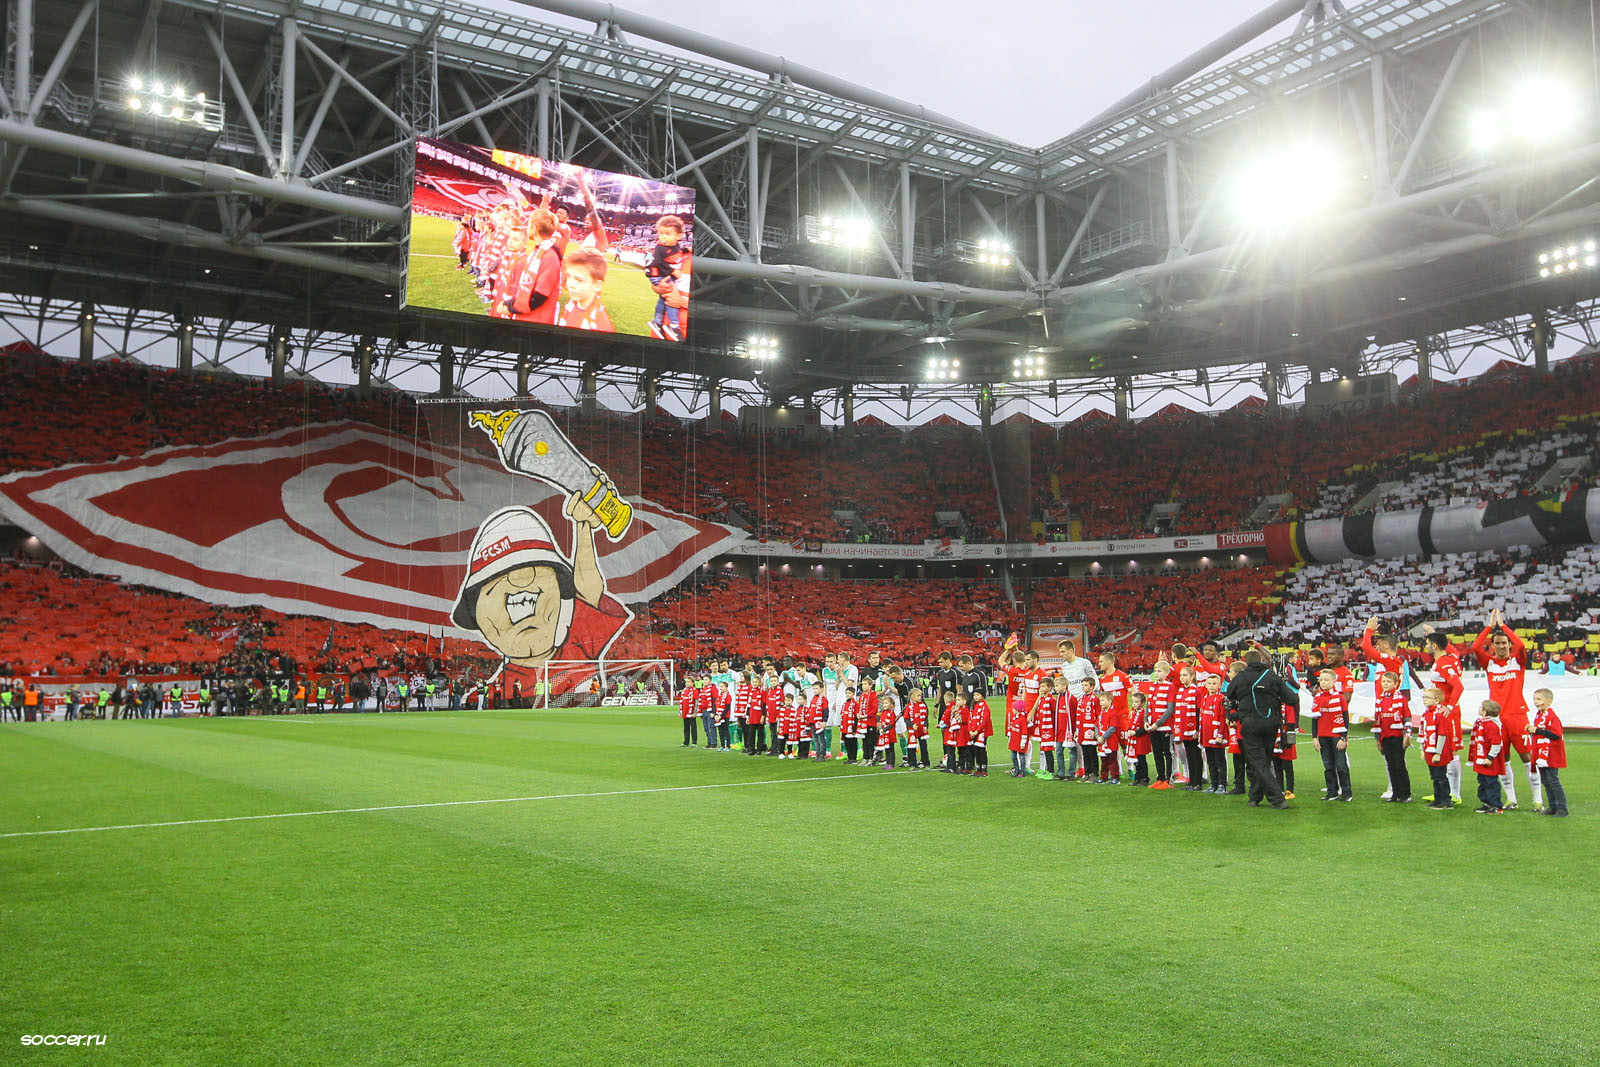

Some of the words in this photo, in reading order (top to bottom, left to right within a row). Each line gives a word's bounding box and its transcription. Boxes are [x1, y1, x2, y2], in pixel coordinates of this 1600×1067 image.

[482, 539, 511, 560] FCSM
[901, 548, 925, 557] здес
[602, 696, 658, 706] GENESIS
[1521, 734, 1533, 747] 71
